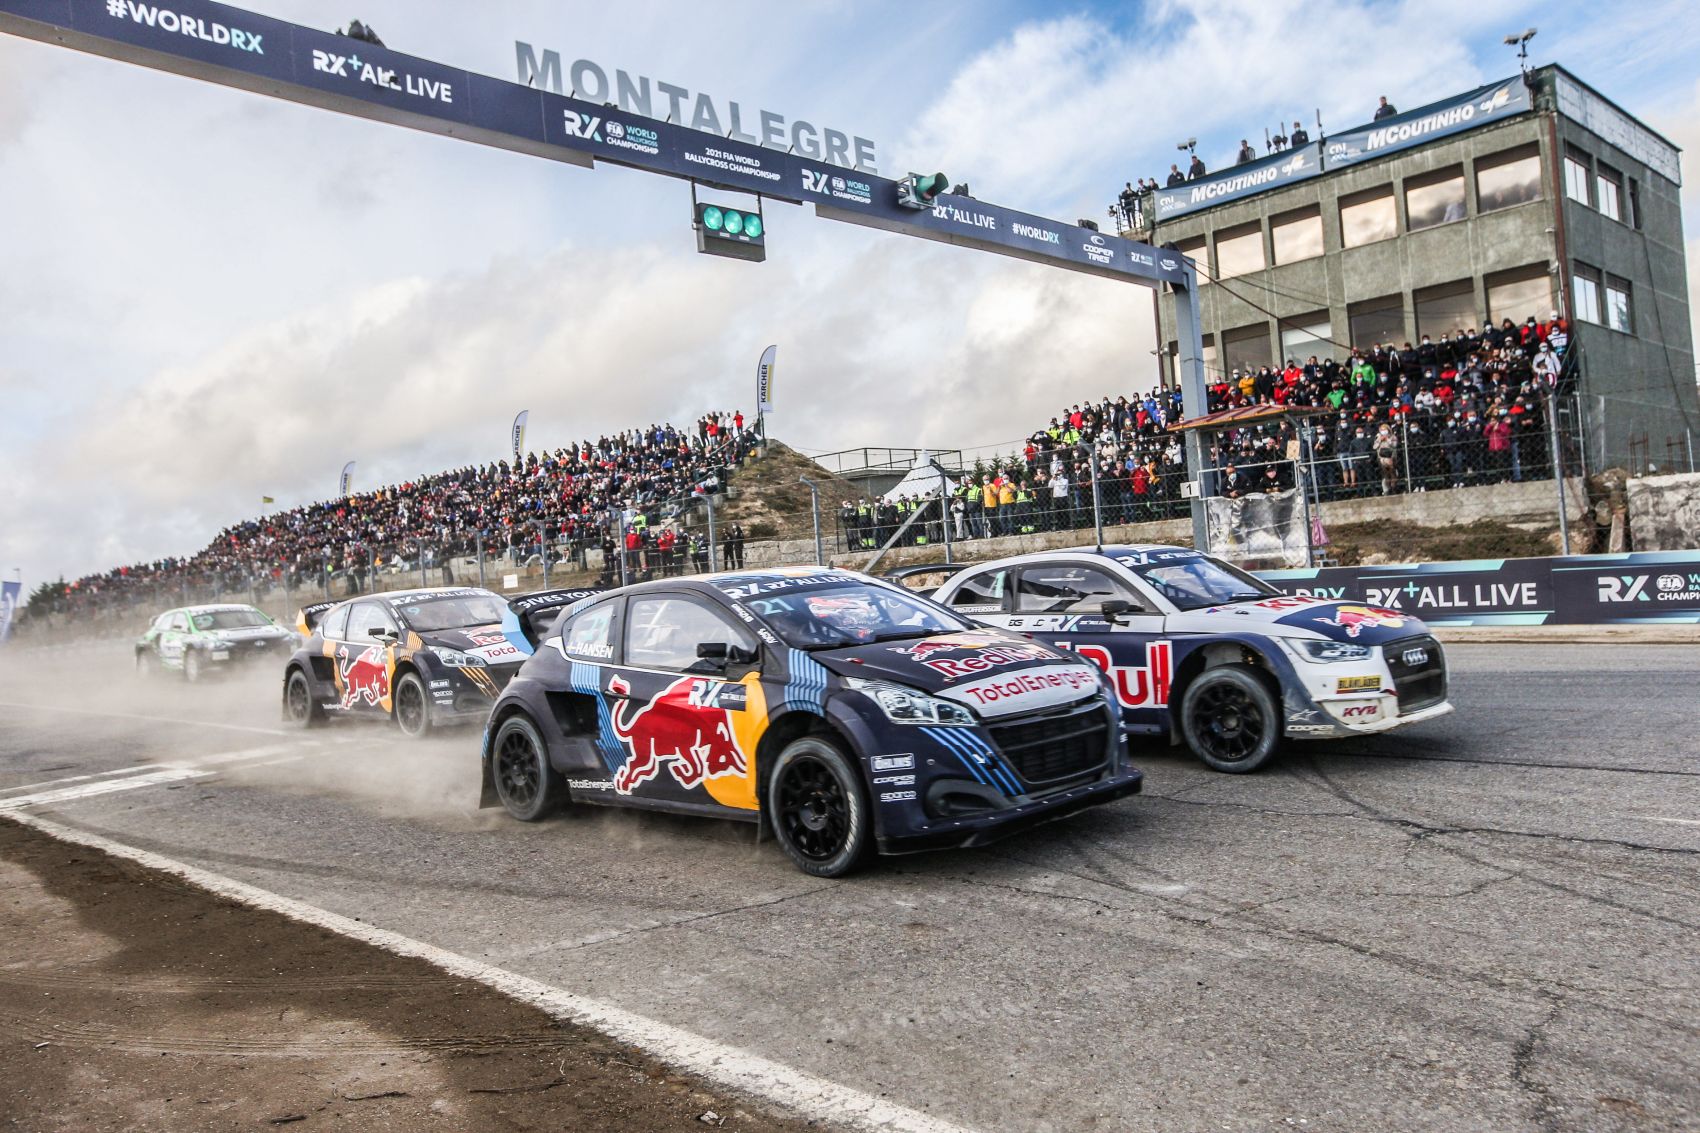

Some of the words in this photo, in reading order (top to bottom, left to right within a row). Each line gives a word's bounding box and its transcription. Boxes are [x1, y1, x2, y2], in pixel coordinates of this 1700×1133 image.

[106, 0, 264, 55] #WORLDRX
[406, 74, 452, 103] LIVE
[515, 40, 878, 175] MONTALEGRE
[563, 109, 602, 142] RX
[606, 123, 623, 136] FIA
[626, 125, 658, 140] WORLD
[1367, 105, 1474, 150] MCOUTINHO
[606, 137, 659, 155] CHAMPIONSHIP
[626, 134, 658, 147] RALLYCROSS
[685, 152, 729, 170] RALLYCROSS
[729, 162, 781, 181] CHAMPIONSHIP
[705, 147, 722, 159] 2021
[723, 151, 736, 162] FIA
[736, 154, 760, 168] WORLD
[801, 168, 830, 194] RX
[846, 180, 870, 191] WORLD
[1191, 167, 1278, 204] MCOUTINHO
[832, 190, 872, 204] CHAMPIONSHIP
[974, 213, 996, 230] LIVE
[1012, 222, 1060, 245] #WORLDRX
[1083, 243, 1114, 258] COOPER
[1087, 252, 1110, 264] TIRES
[1186, 483, 1192, 495] 1
[1598, 574, 1651, 603] RX
[1658, 577, 1683, 591] FIA
[1475, 582, 1538, 606] LIVE
[750, 598, 796, 615] 21
[575, 642, 614, 659] HANSEN
[688, 680, 721, 708] RX
[966, 669, 1095, 704] TotalEnergies
[1342, 705, 1378, 717] KYB
[567, 779, 615, 791] TotalEnergies
